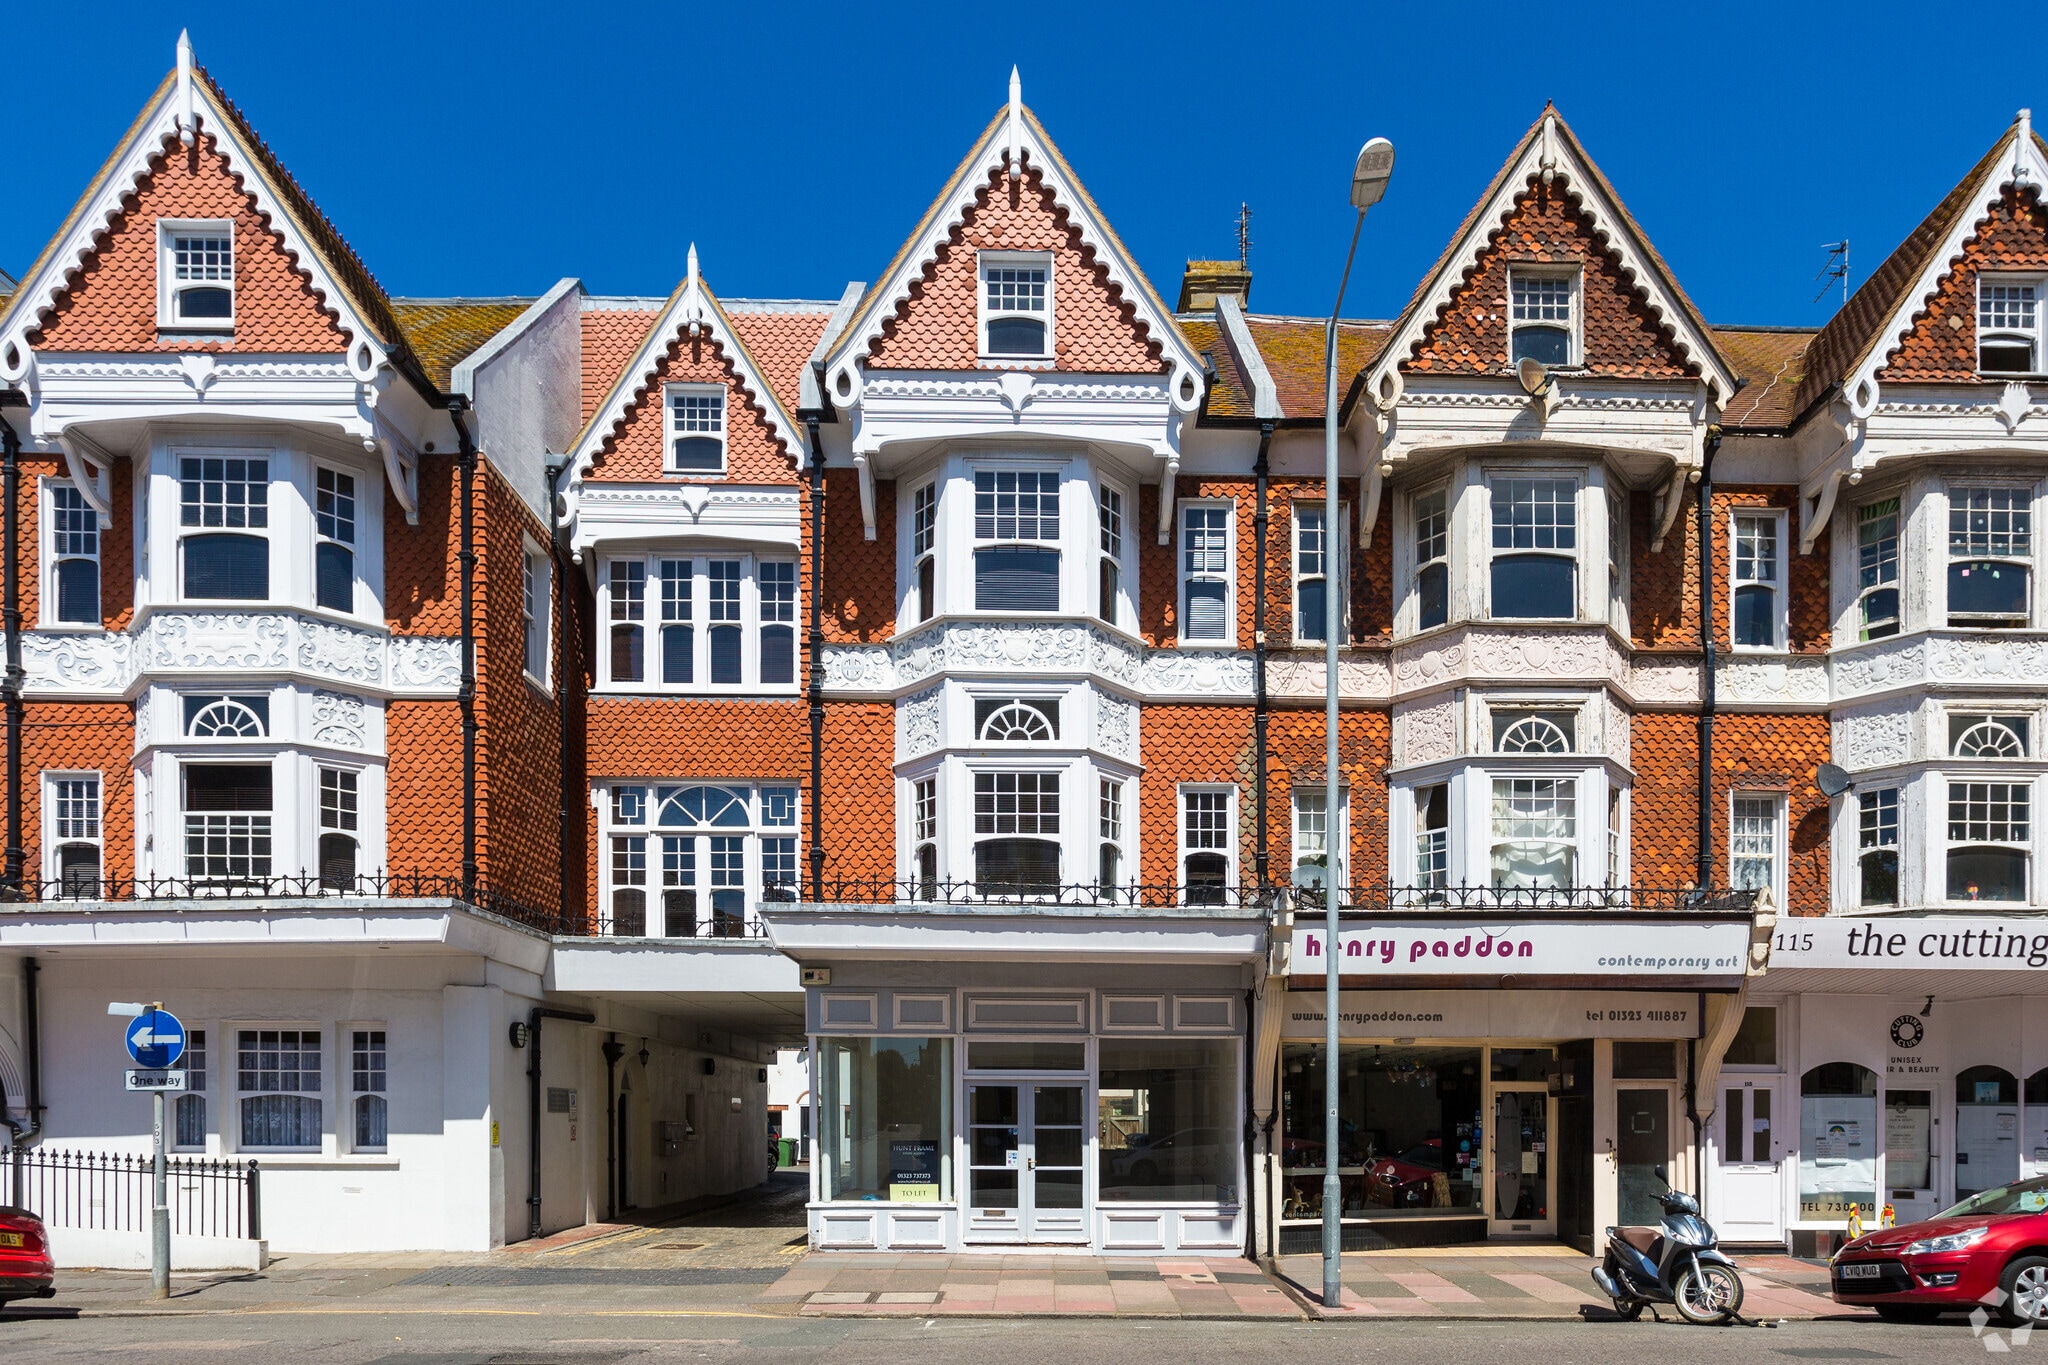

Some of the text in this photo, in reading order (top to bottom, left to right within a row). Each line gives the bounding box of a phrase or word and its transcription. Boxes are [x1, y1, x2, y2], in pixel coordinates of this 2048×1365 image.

[1306, 934, 1533, 964] hnry paddon
[1775, 923, 2048, 968] 115 the cutting
[1597, 954, 1738, 970] contemporary art
[1291, 1010, 1443, 1025] www.enrypaddon.com
[1586, 1010, 1687, 1021] tel 01323 411887
[1891, 1015, 1923, 1031] CUTTING
[1897, 1039, 1918, 1048] CLUB
[1891, 1056, 1922, 1064] UNISEX
[130, 1075, 181, 1087] One way
[1801, 1203, 1875, 1212] TEL 73000
